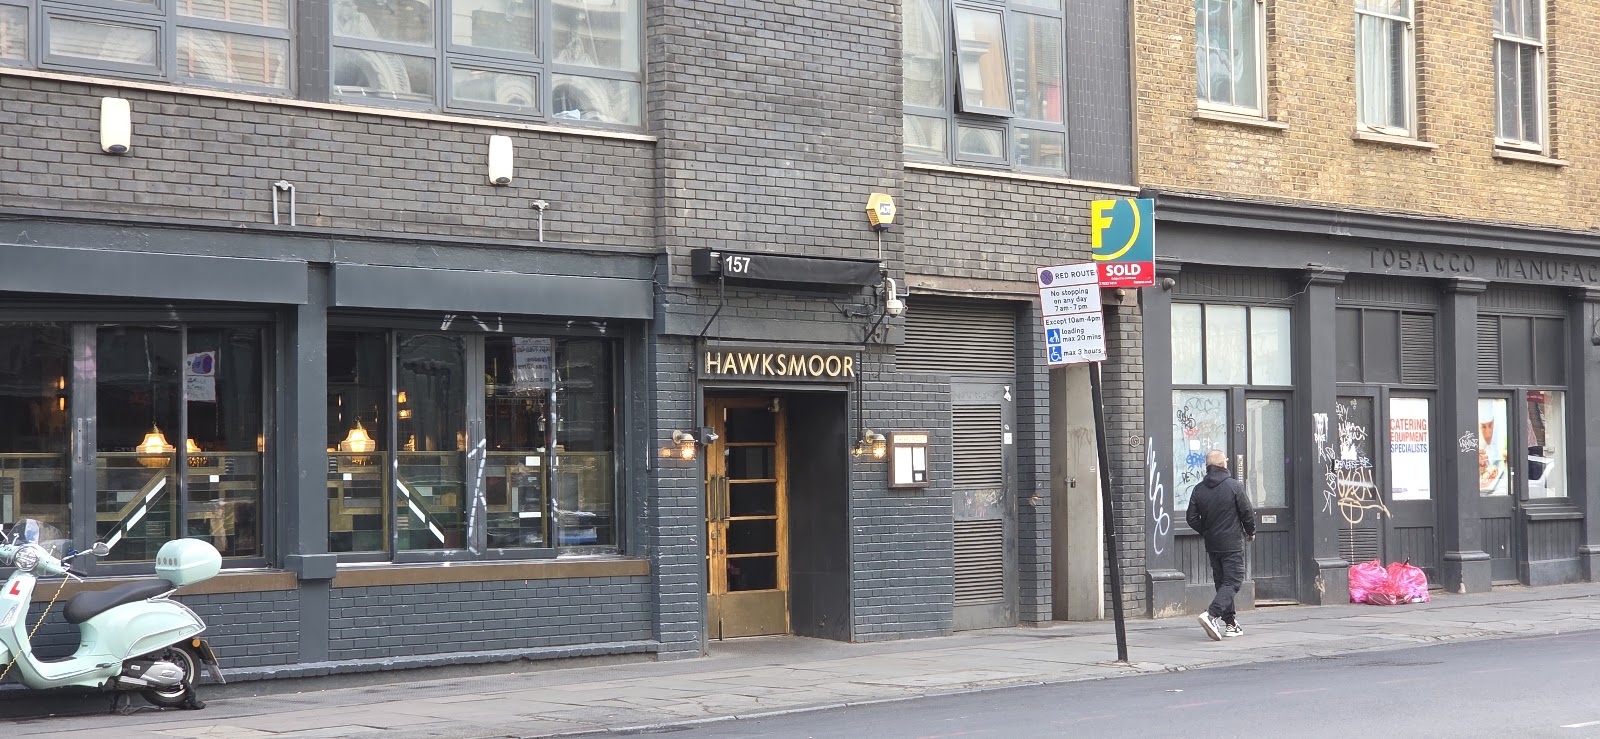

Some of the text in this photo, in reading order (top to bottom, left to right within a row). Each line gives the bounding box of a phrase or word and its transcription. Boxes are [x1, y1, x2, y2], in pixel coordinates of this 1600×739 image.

[725, 255, 751, 274] 157
[1367, 247, 1476, 274] TOBACCO
[1054, 269, 1096, 280] RED ROUTE
[1105, 263, 1142, 277] SOLD
[1061, 287, 1089, 297] stopping
[1063, 297, 1075, 305] any
[1045, 317, 1067, 326] Except
[1061, 327, 1085, 336] loading
[1086, 333, 1102, 341] mins
[1063, 349, 1076, 357] max
[1077, 348, 1082, 356] 3
[704, 351, 856, 378] HAWKSMOOR
[1389, 418, 1427, 431] CATERING
[1390, 431, 1428, 443] EQUIPMENT
[1390, 443, 1428, 454] SPECIALISTS
[9, 580, 20, 596] L
